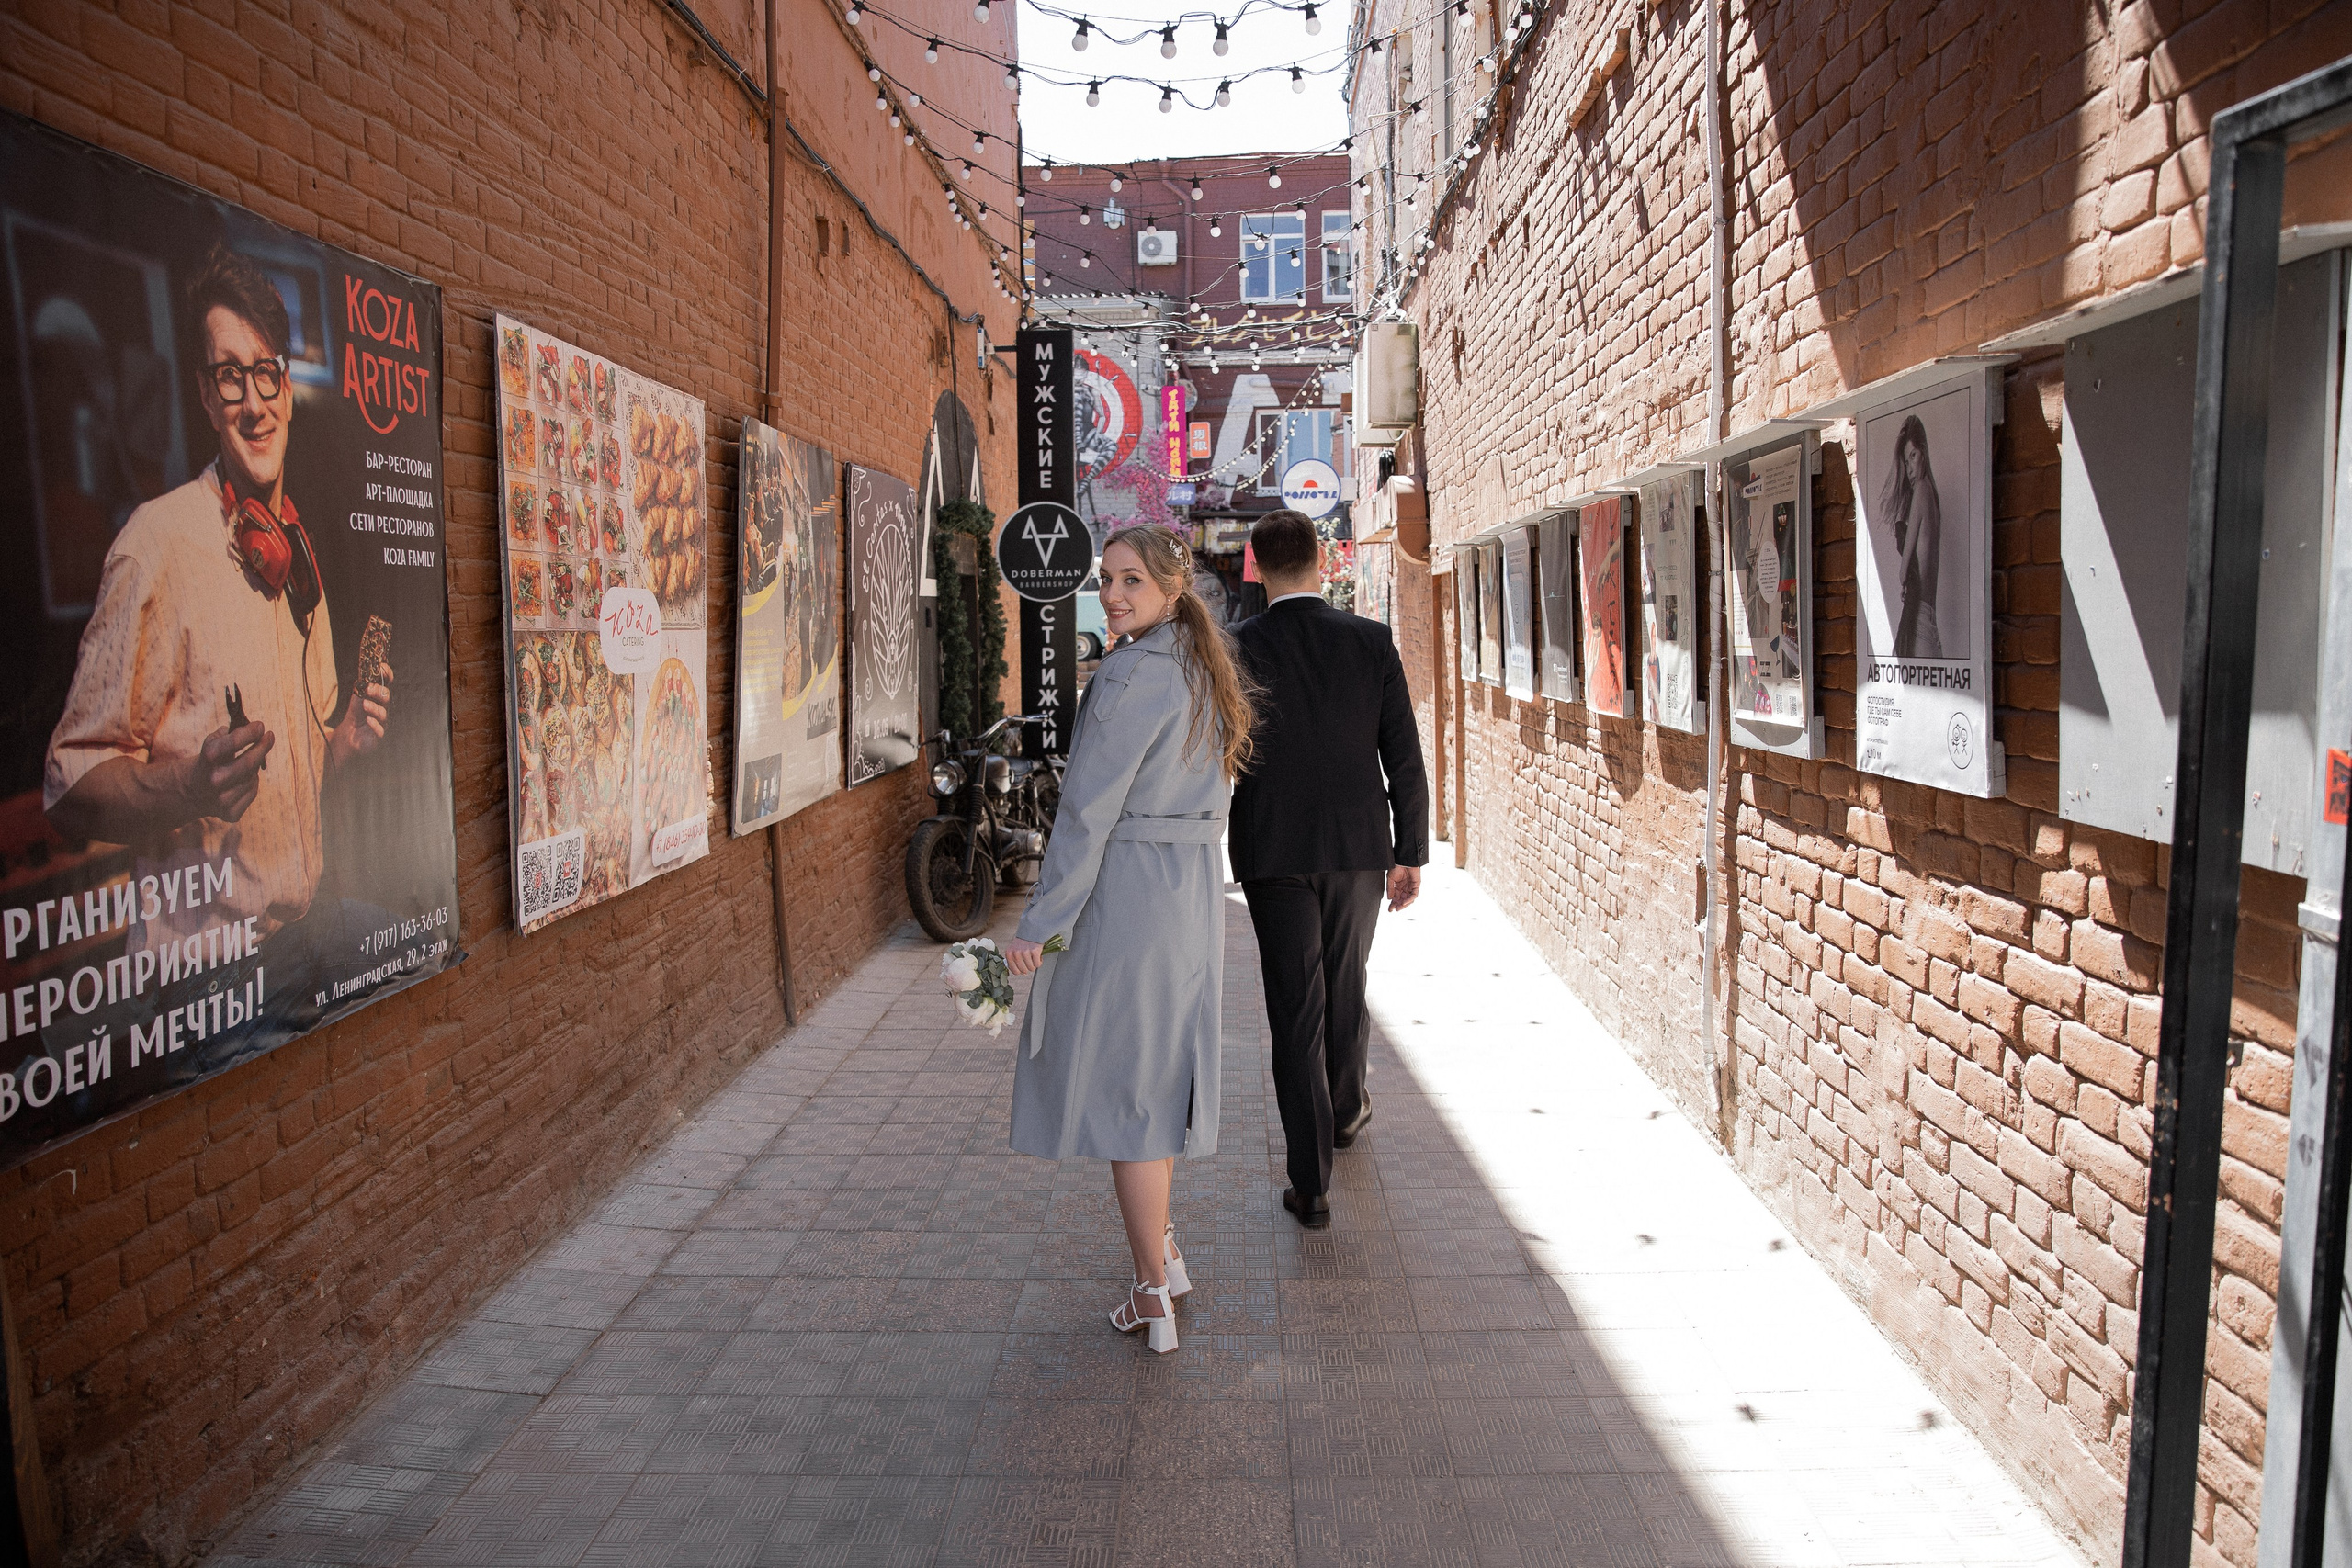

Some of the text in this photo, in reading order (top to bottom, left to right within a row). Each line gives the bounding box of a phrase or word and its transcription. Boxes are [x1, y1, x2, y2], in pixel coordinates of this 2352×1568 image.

[345, 274, 421, 354] KOZA
[343, 342, 430, 434] ARTIST
[1033, 343, 1057, 489] МУЖСКИЕ
[366, 450, 433, 479] БАР-РЕСТОРАН
[366, 482, 434, 509] АРТ-ПЛОЩАДКА
[349, 512, 435, 538] СЕТИ РЕСТОРАНОВ
[383, 547, 435, 568] KOZA FAMILY
[1011, 568, 1082, 579] DOBERMAN
[1019, 580, 1074, 589] BARBERSHOP
[621, 636, 645, 647] CATERING
[1036, 604, 1060, 750] СТРИЖКИ
[1867, 663, 1971, 690] АВТОПОРТРЕТНАЯ
[1867, 716, 1889, 727] ФОТОГРАФ
[359, 906, 448, 956] +7 (917) 163-36-03
[406, 947, 420, 967] 29,
[421, 942, 427, 961] 2
[130, 966, 265, 1068] МЕЧТЫ!
